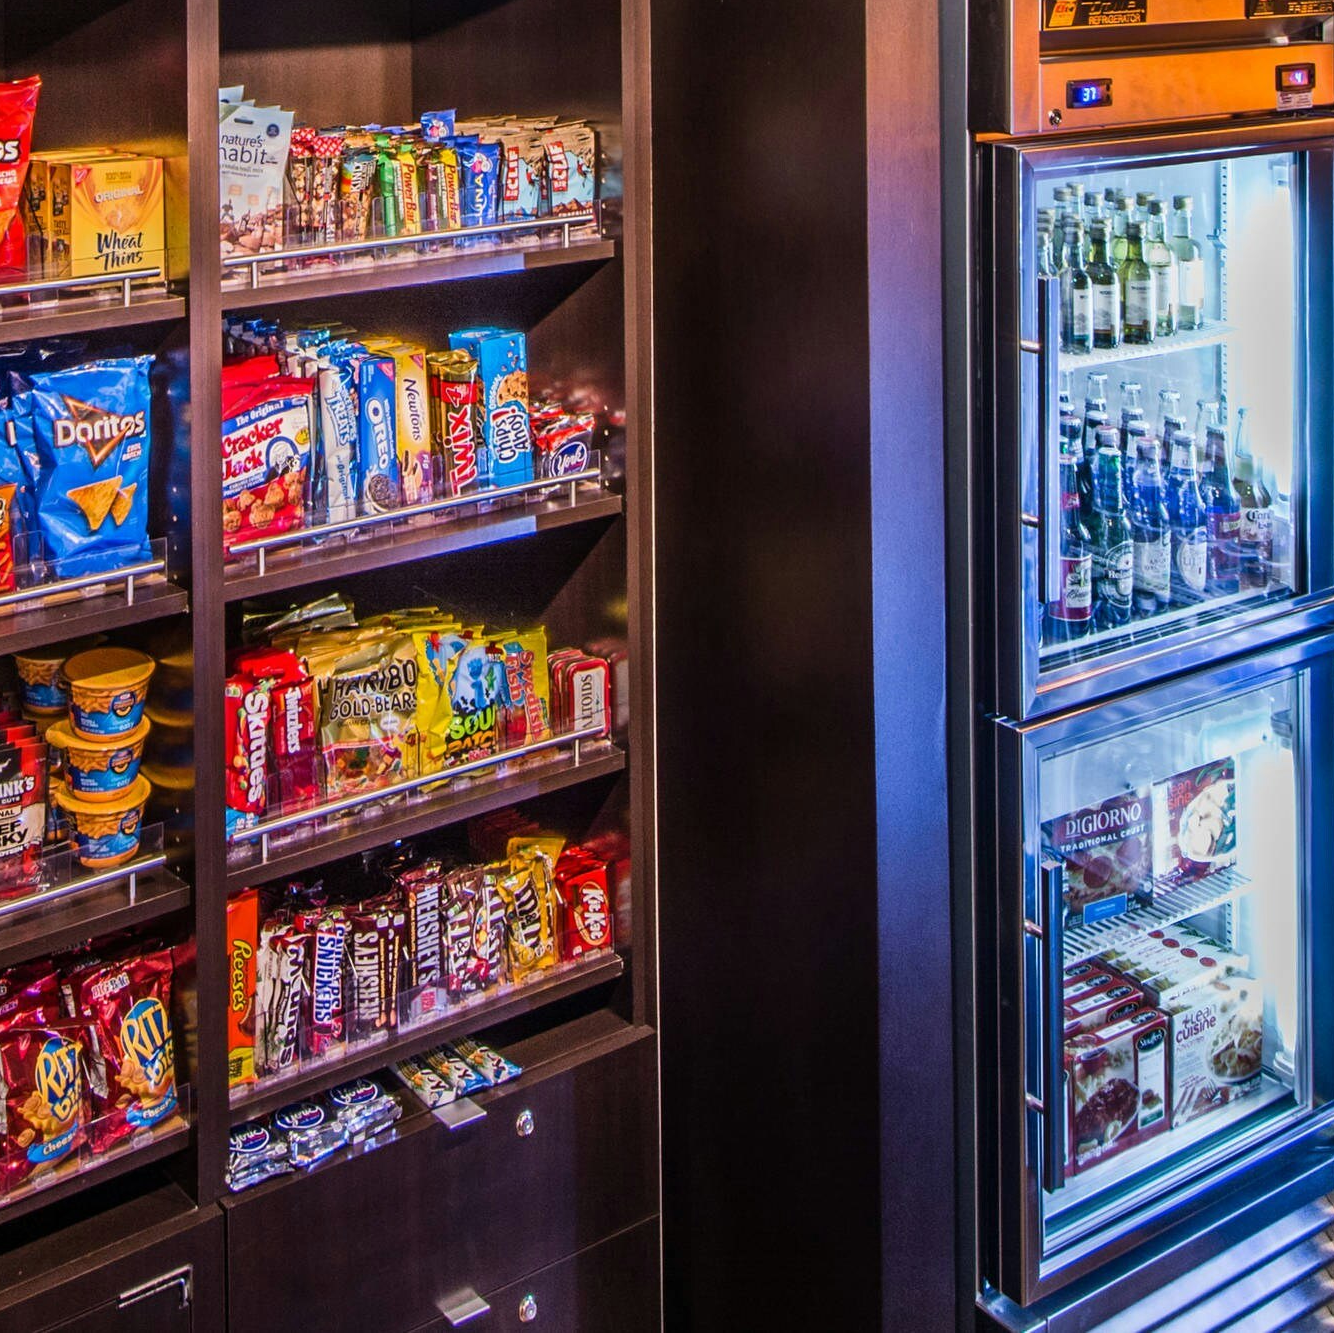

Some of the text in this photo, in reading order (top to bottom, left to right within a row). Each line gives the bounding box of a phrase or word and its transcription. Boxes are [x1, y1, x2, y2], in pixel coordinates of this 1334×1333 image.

[1089, 14, 1140, 25] REFRIGERATOR
[1288, 4, 1332, 13] FREEZER
[1083, 87, 1096, 102] 37
[221, 135, 262, 148] nature's
[549, 141, 568, 180] CLIF
[508, 147, 519, 189] CLIF
[94, 187, 144, 203] ORIGINAL
[402, 163, 417, 224] PowerBar
[446, 164, 460, 223] PowerBar
[94, 249, 144, 272] Thins
[96, 229, 144, 254] Wheat
[55, 412, 145, 447] Doritos
[236, 401, 284, 426] The Original
[326, 393, 349, 446] TREATS
[403, 379, 422, 441] Newtons
[222, 418, 283, 458] Cracker
[366, 399, 388, 469] OREO
[443, 408, 477, 495] TWIX
[497, 419, 516, 462] Chips
[222, 449, 264, 480] Jack
[332, 659, 417, 702] HARIBO
[505, 651, 546, 742] Swedish Fish
[581, 674, 593, 729] ALTOIDS
[245, 692, 268, 804] Skittles
[1, 796, 20, 804] CUTS
[1170, 780, 1192, 796] ean
[1060, 824, 1145, 853] TRADITIONAL CRUST
[1066, 803, 1142, 837] DIGIORNO
[582, 888, 606, 940] Kit Kat
[417, 886, 440, 986] HERSHEY'S
[232, 939, 253, 1012] Reese's
[315, 935, 334, 1023] SNICKERS
[355, 932, 379, 1019] HERSHEY'S
[122, 1003, 172, 1069] RITZ
[1176, 1016, 1217, 1043] cuisine
[39, 1042, 83, 1104] RITZ
